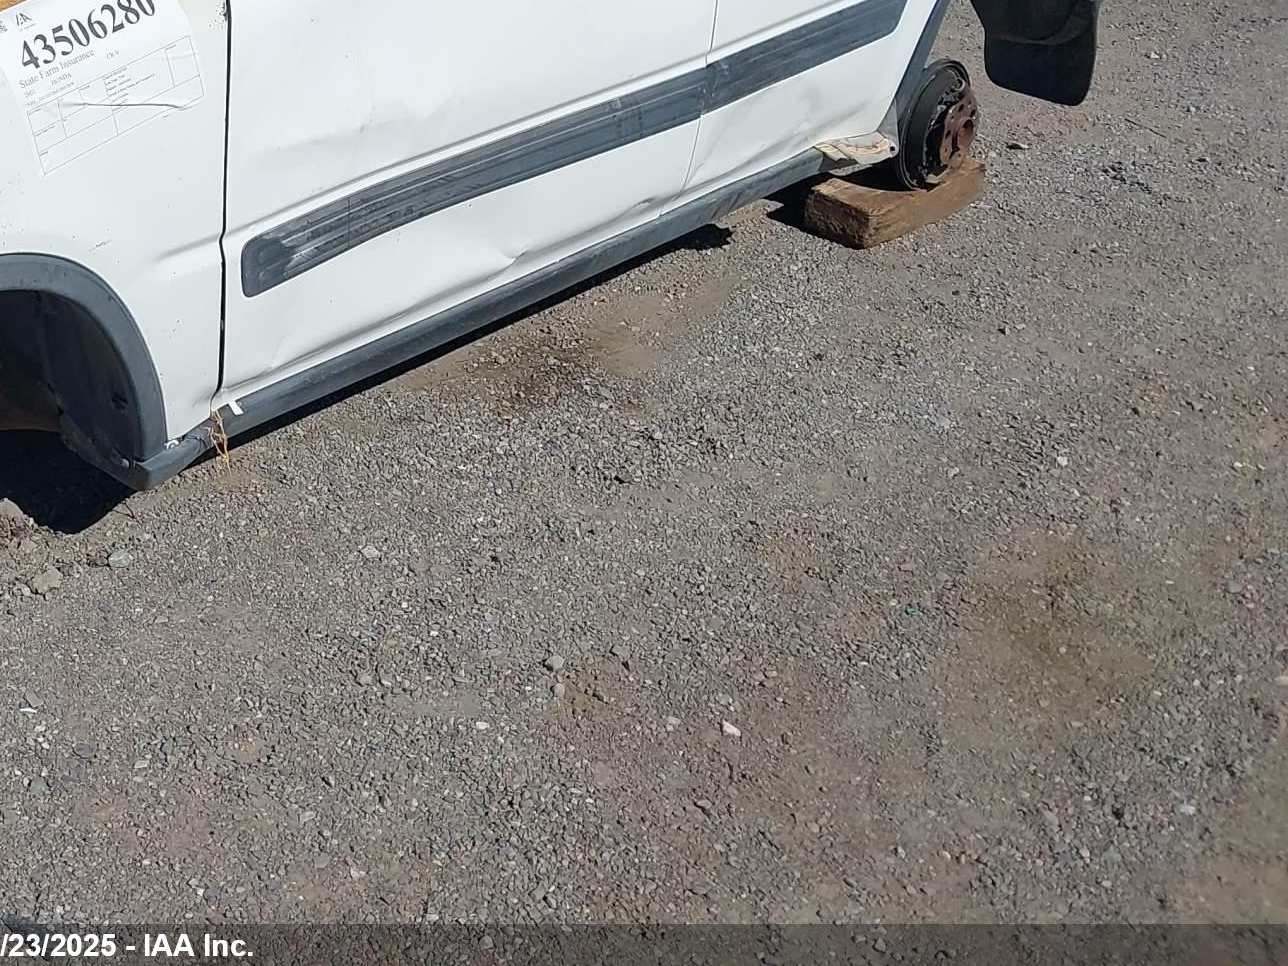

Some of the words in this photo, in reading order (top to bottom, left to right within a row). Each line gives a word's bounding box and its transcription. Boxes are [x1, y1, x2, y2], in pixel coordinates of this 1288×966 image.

[19, 72, 38, 89] State
[39, 65, 59, 80] Farm
[60, 49, 95, 71] Insurance
